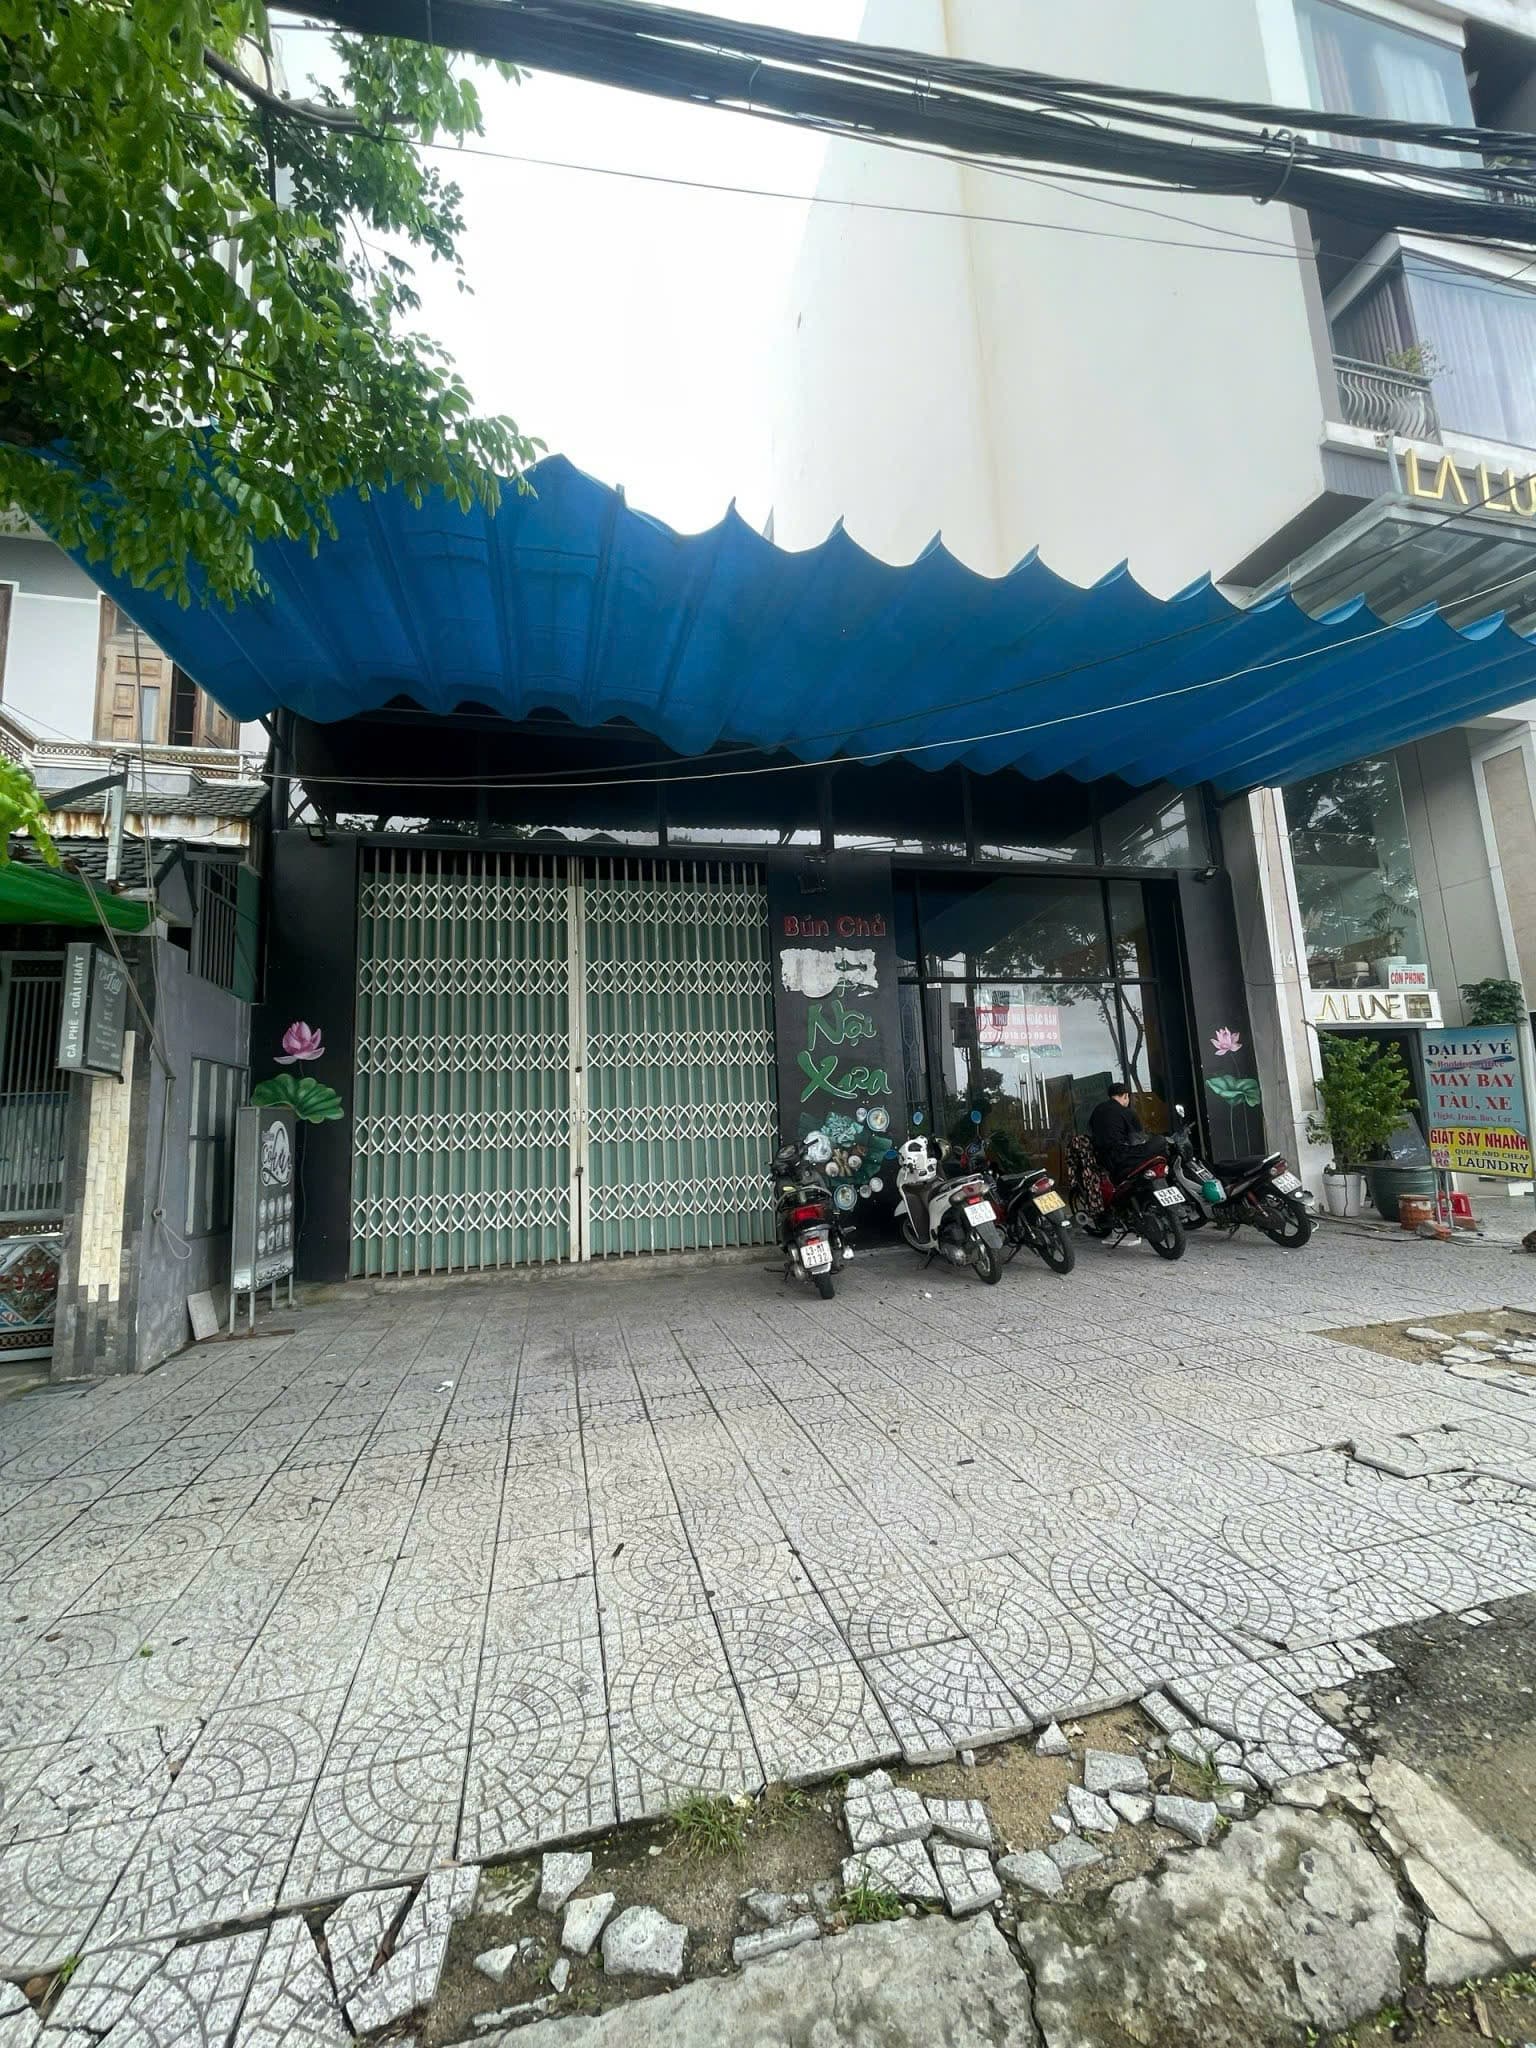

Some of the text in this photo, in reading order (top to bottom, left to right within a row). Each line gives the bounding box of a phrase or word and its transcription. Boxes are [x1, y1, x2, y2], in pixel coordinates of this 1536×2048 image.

[784, 914, 886, 936] Bún Chả
[1427, 1039, 1513, 1059] ĐẠI LÝ VÉ
[1476, 1074, 1516, 1088] BAY
[1485, 1096, 1513, 1111] XE
[1484, 1132, 1529, 1151] NHANH
[1458, 1157, 1529, 1174] LAUNDRY
